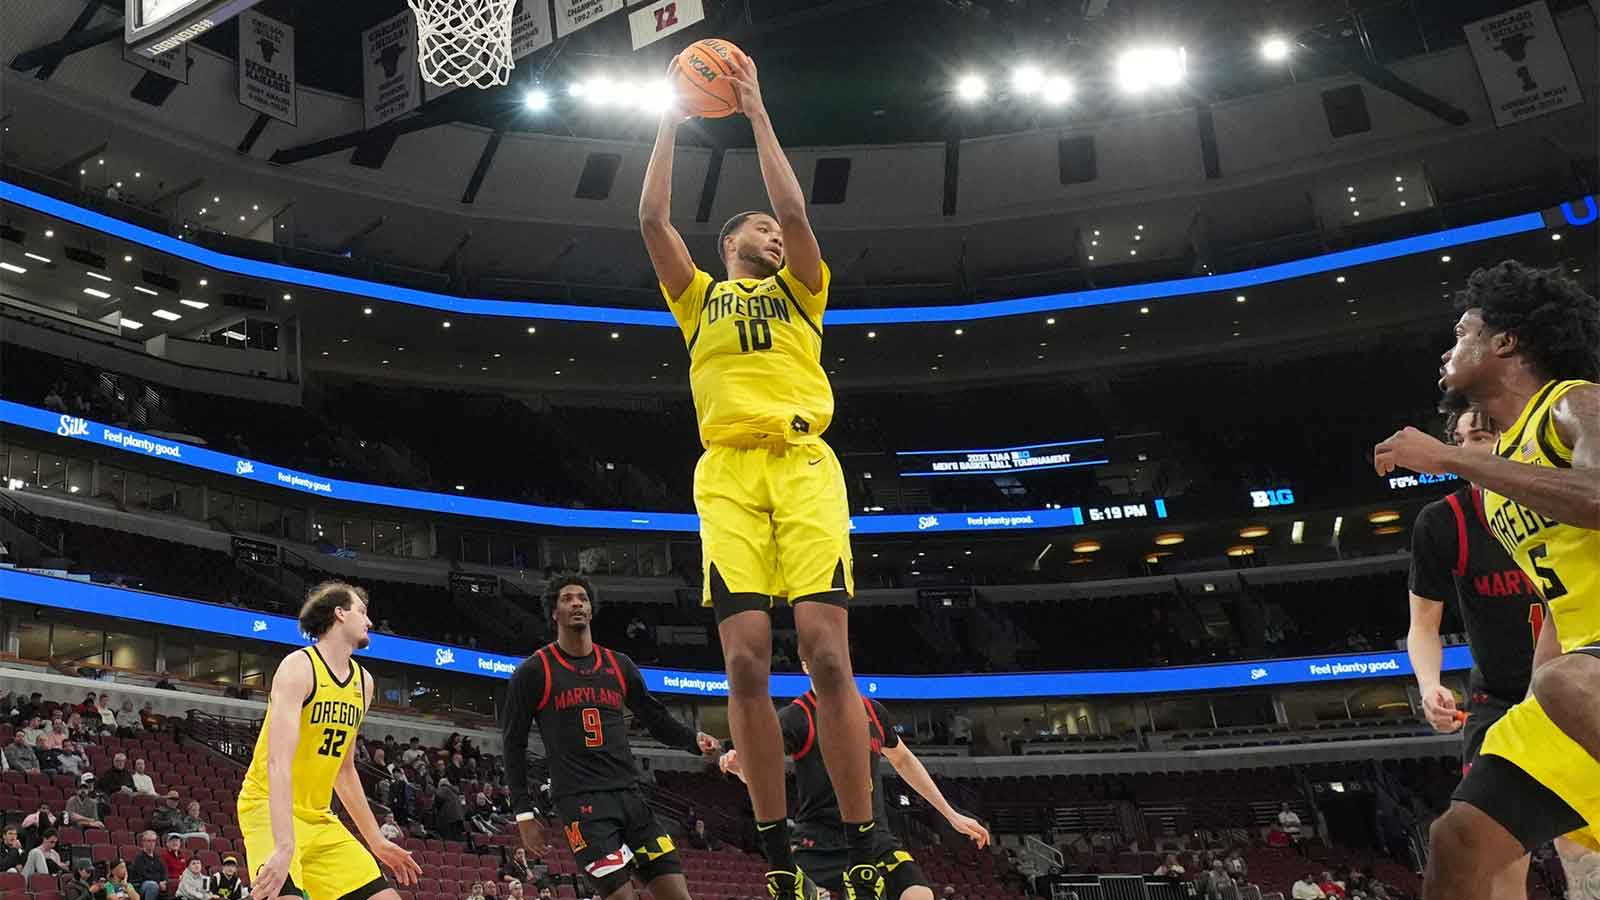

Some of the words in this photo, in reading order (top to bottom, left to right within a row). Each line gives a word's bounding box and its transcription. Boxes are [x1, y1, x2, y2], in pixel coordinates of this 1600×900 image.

[654, 2, 678, 33] 72
[707, 293, 791, 325] OREGON
[734, 319, 774, 353] 10
[57, 415, 89, 437] Silk
[104, 429, 123, 443] Feel
[123, 434, 154, 452] planty
[155, 443, 182, 457] good.
[236, 460, 254, 475] Silk
[959, 460, 1013, 471] BASKETBALL
[1013, 453, 1071, 468] TOURNAMENT
[990, 452, 1011, 462] TIAA
[1389, 476, 1419, 489] FG%
[1250, 489, 1295, 507] B1G
[918, 515, 940, 530] Silk
[1123, 504, 1148, 518] PM
[1528, 542, 1569, 600] 5
[435, 647, 456, 666] Silk
[478, 657, 493, 670] Feel
[1310, 663, 1332, 675] Feel
[1331, 661, 1367, 676] planty
[1368, 658, 1400, 673] good.
[554, 687, 623, 712] MARYLAND
[310, 701, 362, 728] OREGON
[582, 707, 604, 748] 9
[318, 728, 347, 758] 32
